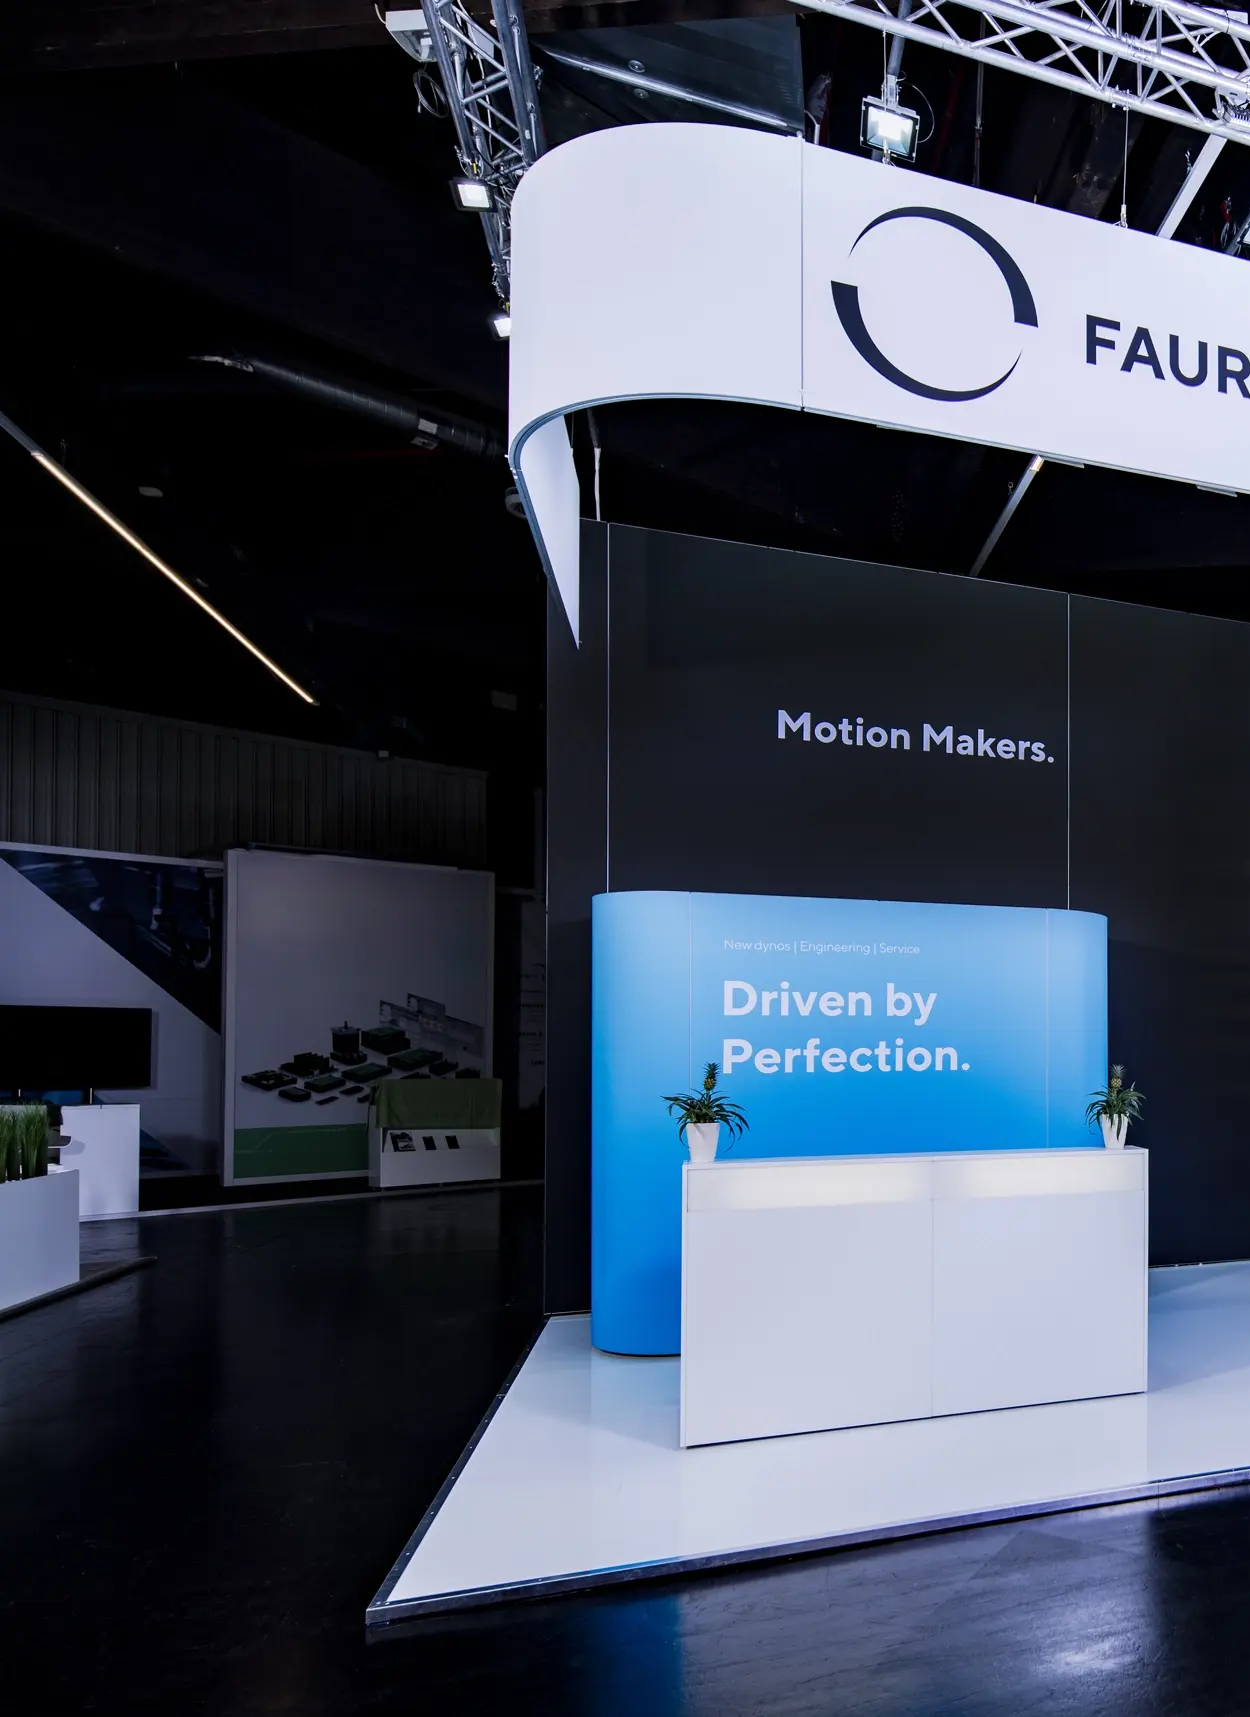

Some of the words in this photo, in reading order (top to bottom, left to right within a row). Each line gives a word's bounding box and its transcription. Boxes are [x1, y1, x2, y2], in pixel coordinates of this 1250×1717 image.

[777, 709, 911, 750] Motion
[922, 723, 1055, 764] Makers.
[724, 939, 752, 951] New
[754, 940, 791, 953] dynos
[800, 941, 871, 955] Engineering
[879, 943, 920, 954] Service
[723, 980, 872, 1016] Driven
[886, 982, 937, 1026] by
[722, 1037, 971, 1074] Perfection.
